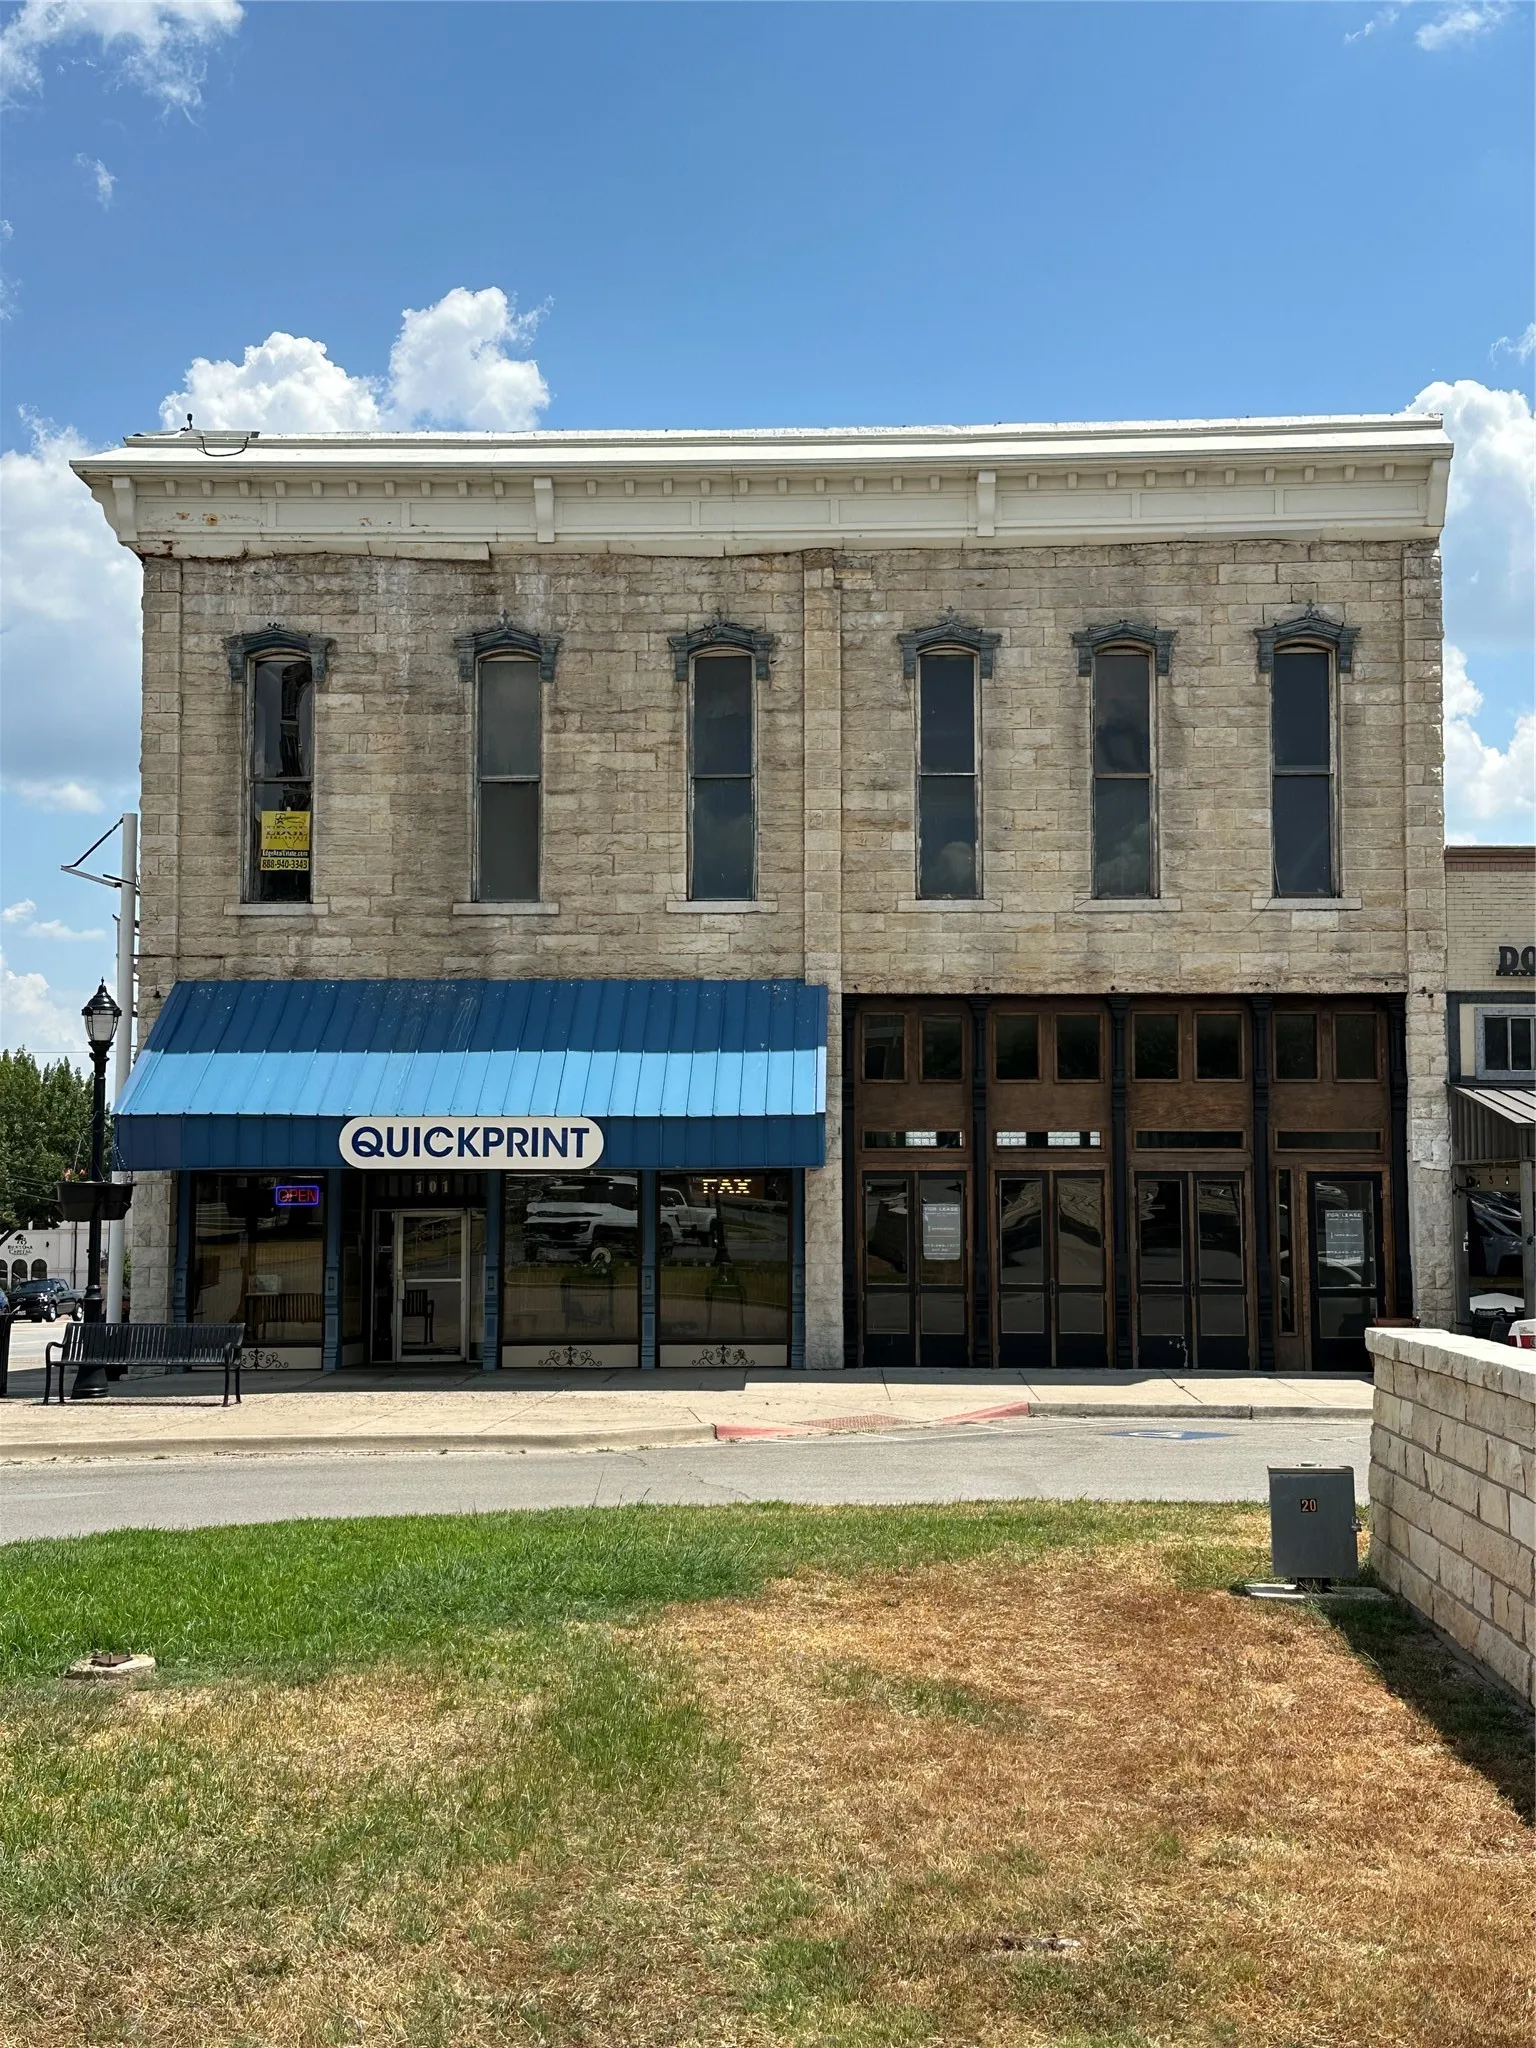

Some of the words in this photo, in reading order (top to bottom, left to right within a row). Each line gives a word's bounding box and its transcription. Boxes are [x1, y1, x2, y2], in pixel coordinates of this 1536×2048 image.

[262, 859, 308, 869] 888-940-3343
[351, 1126, 590, 1158] QUICKPRINT
[415, 1180, 449, 1194] 101
[702, 1178, 752, 1194] FAX
[278, 1188, 318, 1203] OPEN
[1301, 1499, 1317, 1512] 20
